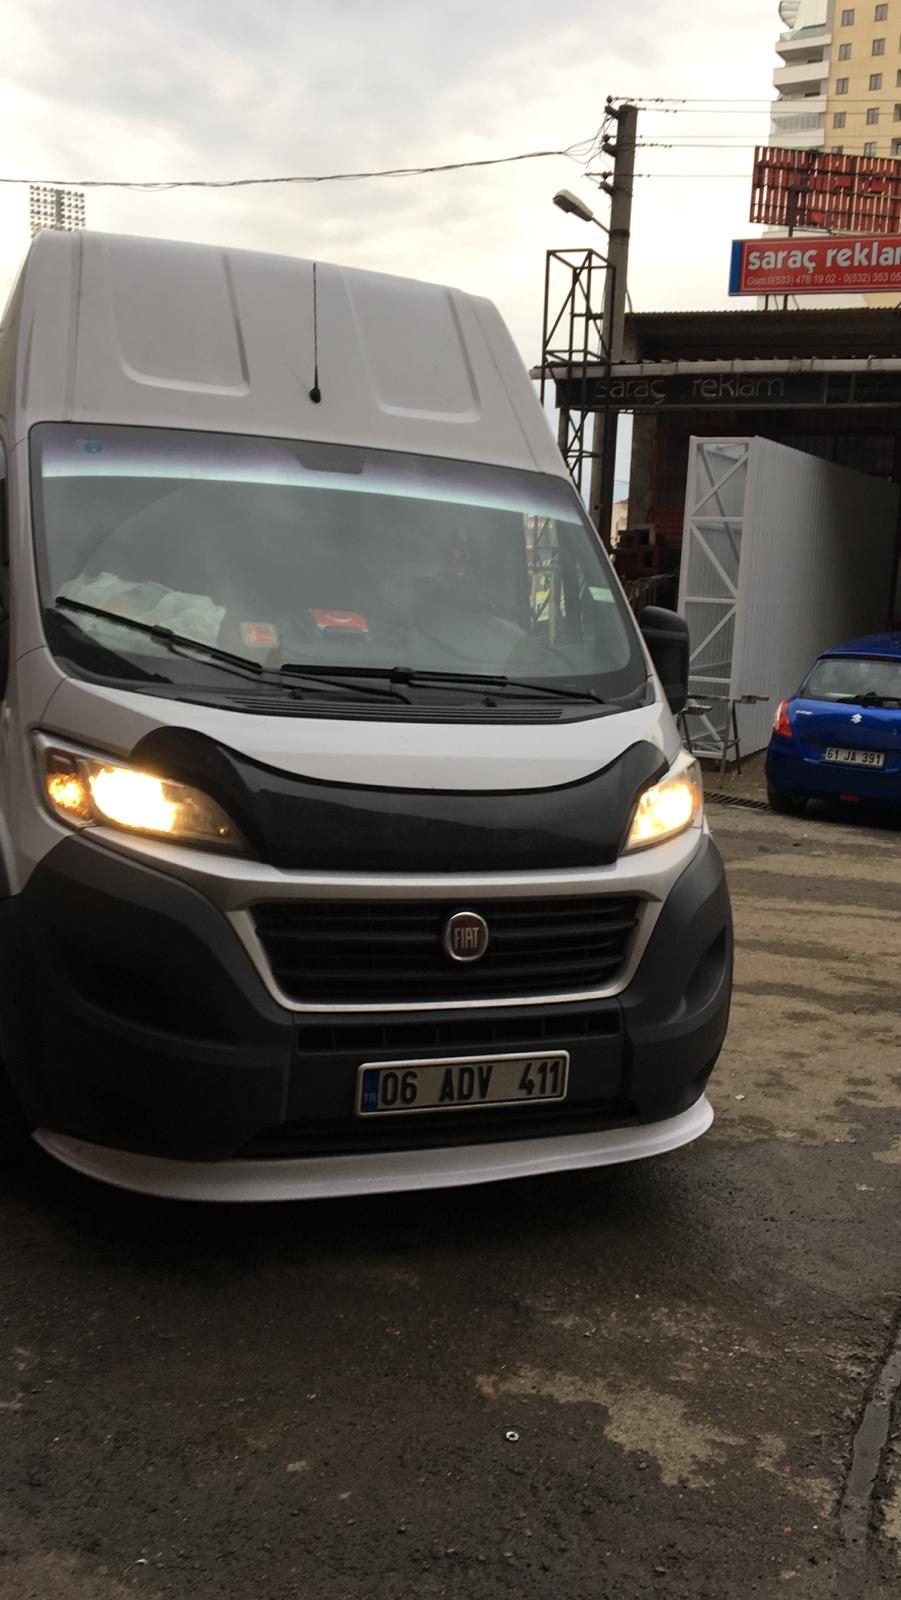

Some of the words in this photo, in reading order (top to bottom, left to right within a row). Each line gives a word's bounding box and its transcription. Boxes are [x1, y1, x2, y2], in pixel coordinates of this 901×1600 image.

[748, 249, 818, 273] saraç
[595, 379, 666, 404] saraç
[692, 373, 785, 398] reklam
[827, 749, 840, 761] 61
[843, 751, 857, 761] JA
[862, 752, 881, 765] 391
[454, 927, 480, 950] FIAT
[380, 1071, 418, 1106] 06
[439, 1065, 494, 1102] ADV
[518, 1060, 561, 1096] 411
